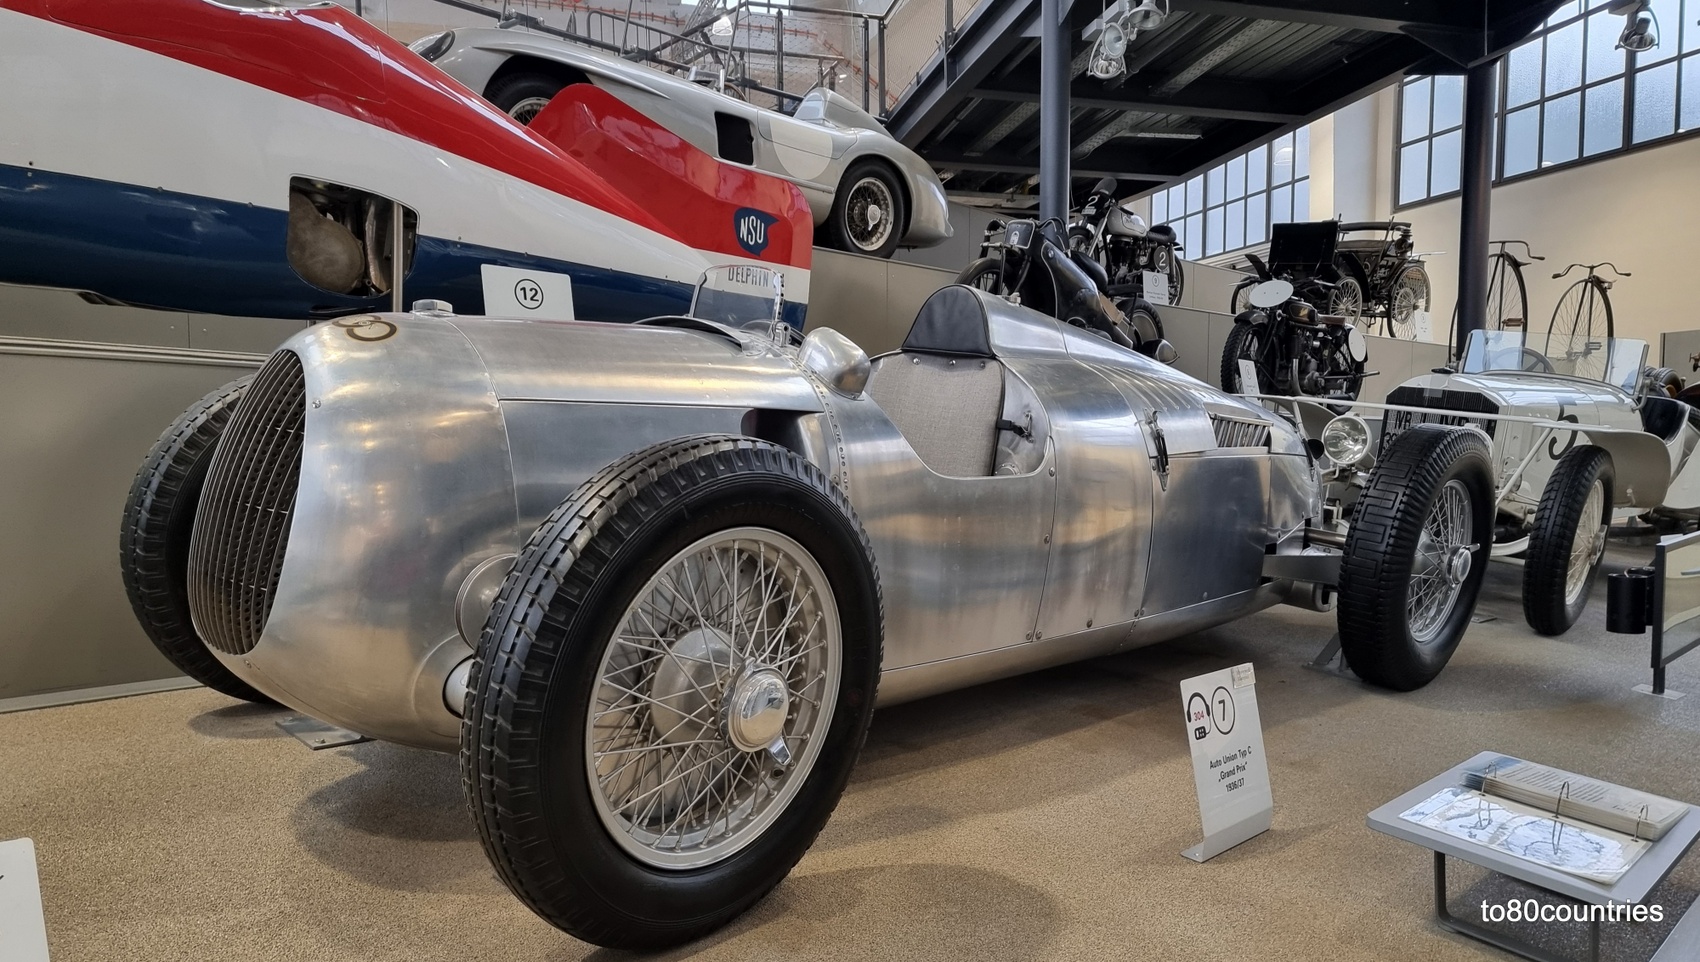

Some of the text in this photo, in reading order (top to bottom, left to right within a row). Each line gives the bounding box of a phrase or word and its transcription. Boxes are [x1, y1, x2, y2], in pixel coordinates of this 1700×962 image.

[1085, 195, 1099, 209] 2
[740, 215, 765, 246] NSU
[1159, 251, 1167, 267] 2
[727, 267, 769, 288] DELPHIN
[519, 286, 540, 302] 12
[1548, 395, 1579, 461] 5
[1194, 699, 1225, 721] 304 7
[1209, 745, 1252, 770] Auto Union Typ C
[1225, 777, 1245, 793] 1936/37
